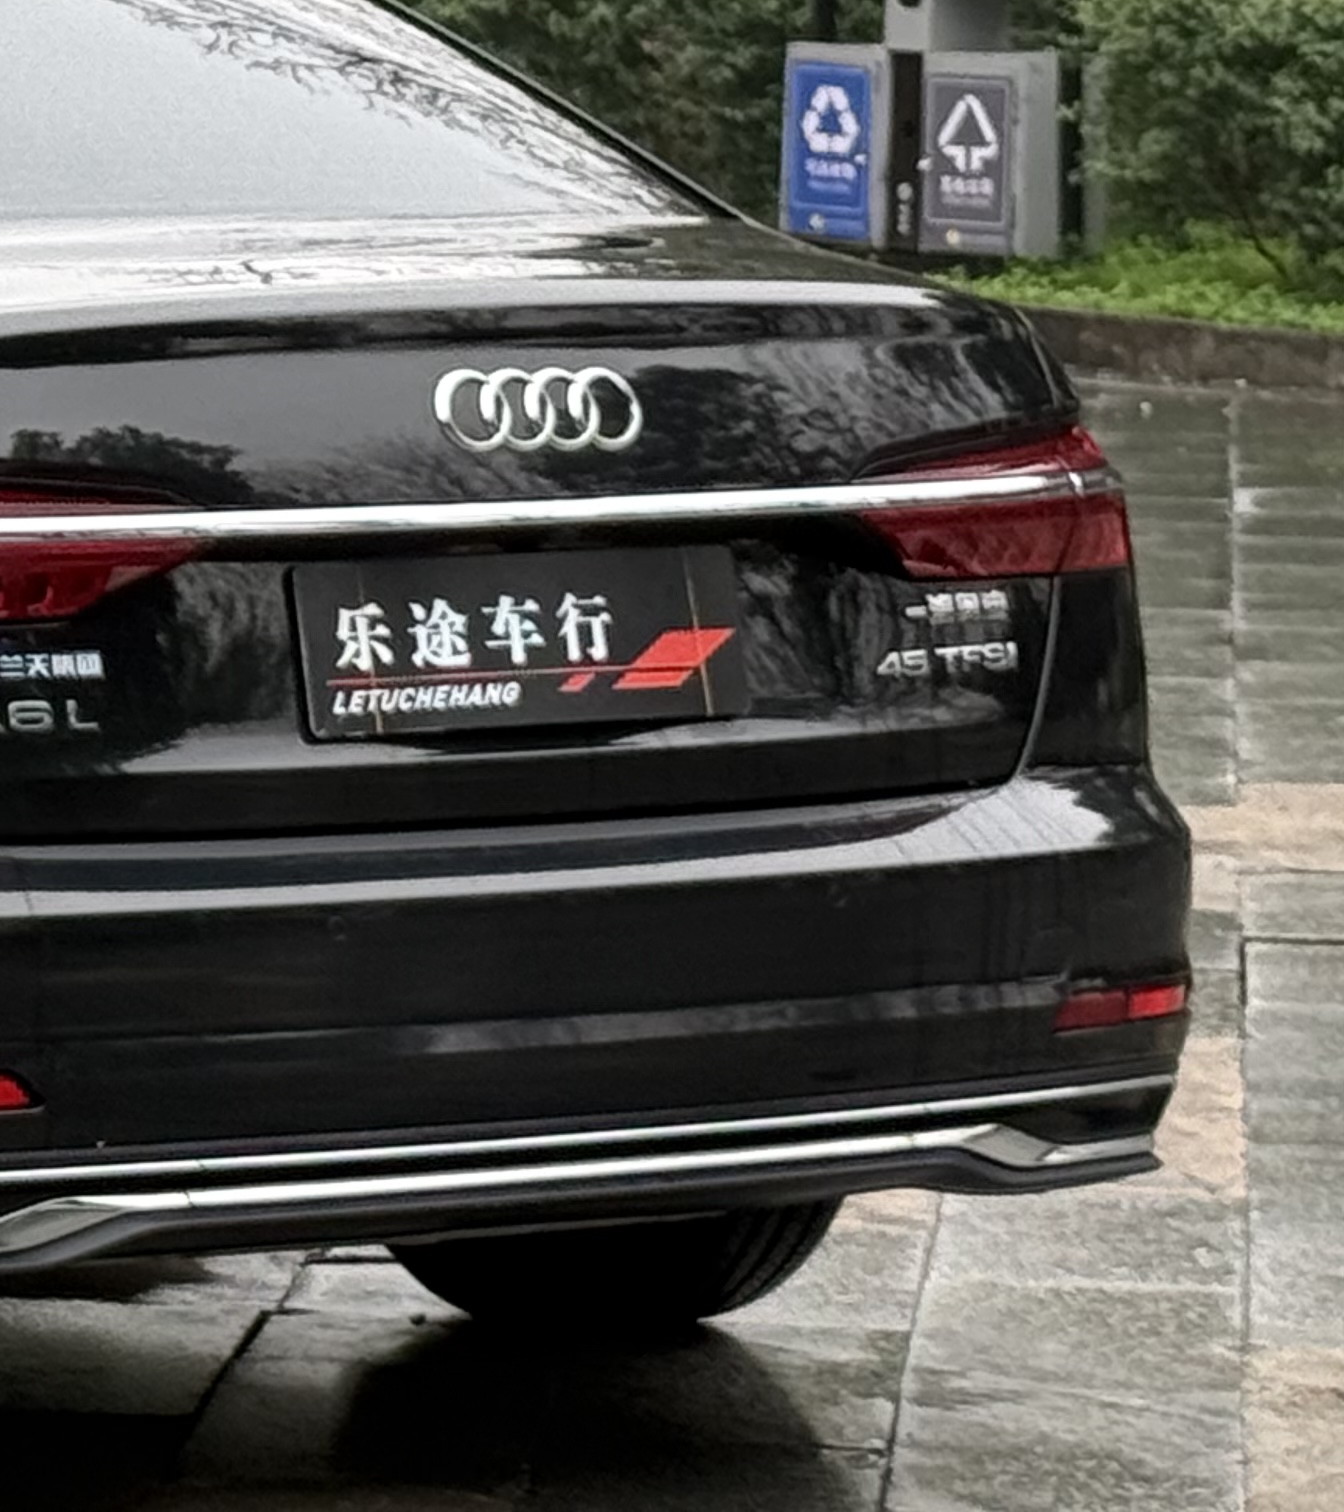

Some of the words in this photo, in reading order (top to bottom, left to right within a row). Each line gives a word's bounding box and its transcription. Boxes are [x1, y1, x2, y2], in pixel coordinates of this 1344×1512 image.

[334, 592, 614, 671] 乐途车行
[876, 647, 931, 679] 45
[933, 640, 1019, 675] TFSI
[332, 681, 522, 715] LETUCHEHANG
